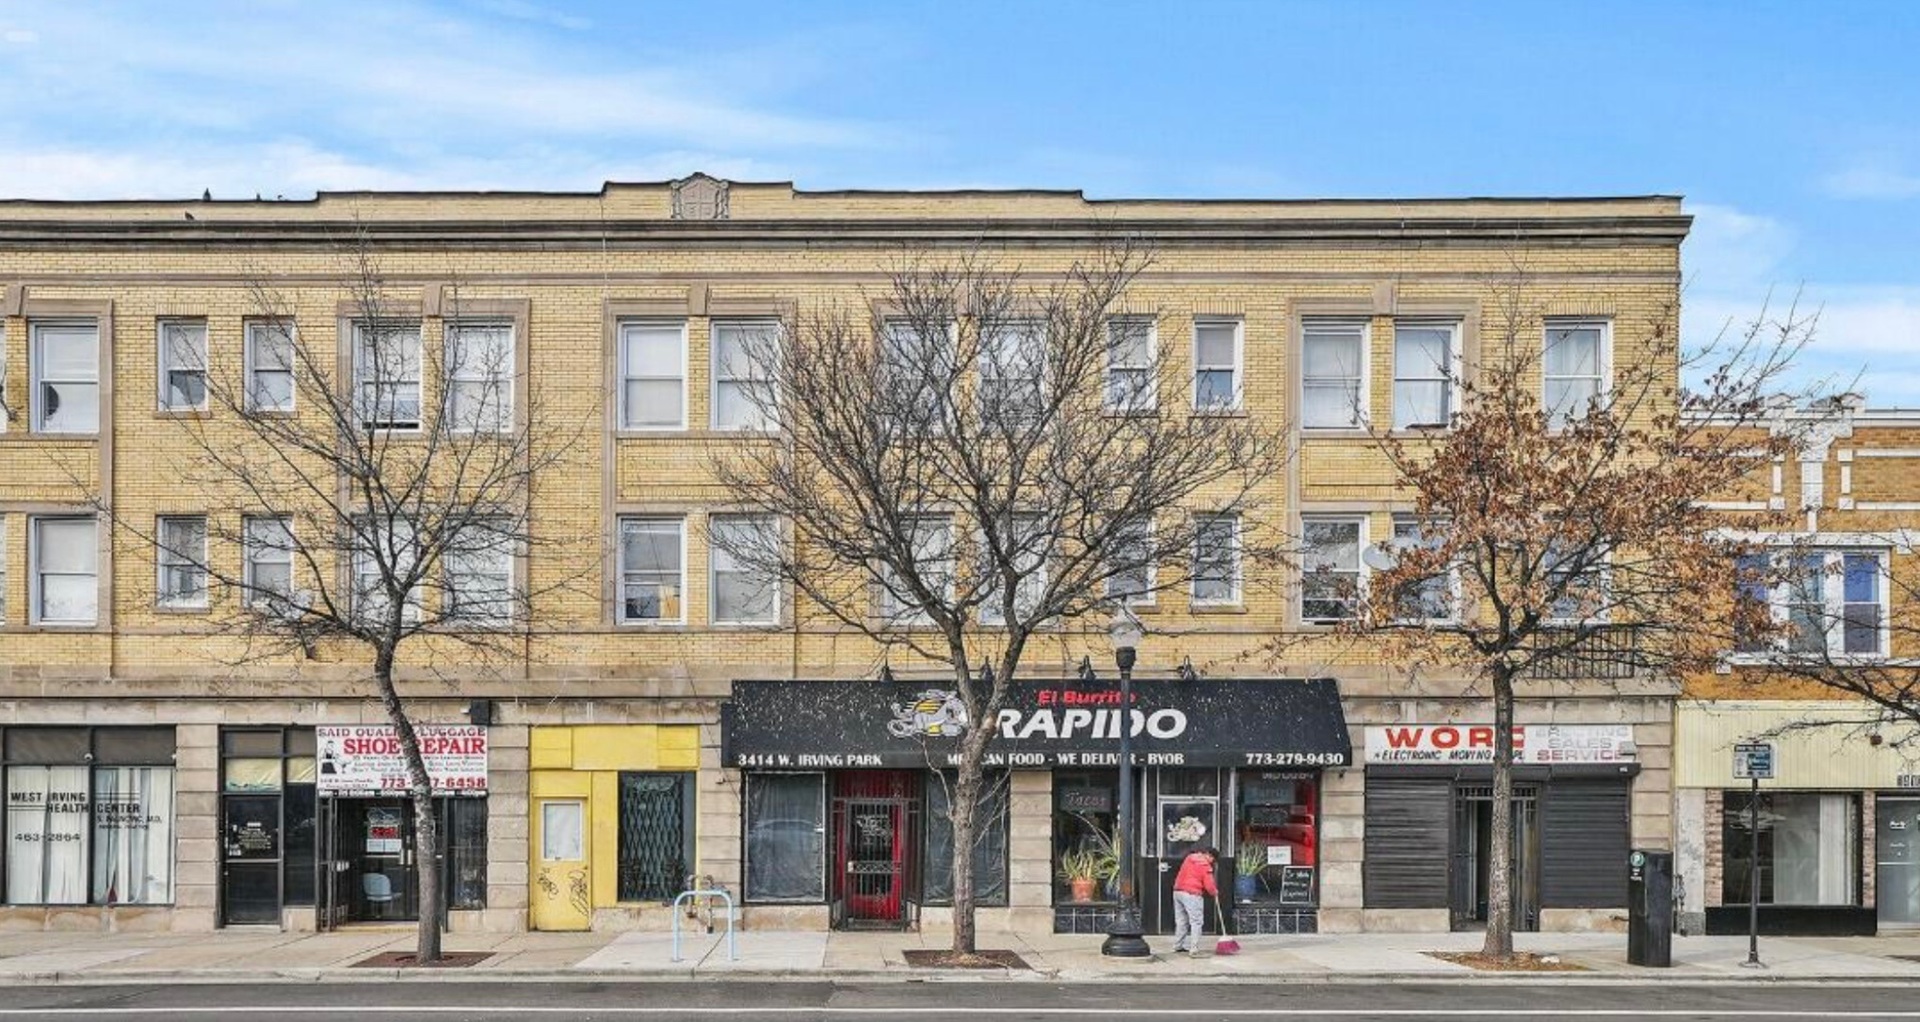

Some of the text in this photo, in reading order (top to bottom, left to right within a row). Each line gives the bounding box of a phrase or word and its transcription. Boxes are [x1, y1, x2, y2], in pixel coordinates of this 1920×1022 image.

[1038, 690, 1058, 704] El
[993, 708, 1188, 739] RAPIDO
[318, 728, 350, 737] SAID
[420, 727, 486, 737] LUGGAGE
[343, 738, 401, 755] SHOE
[1548, 737, 1612, 749] SALES
[737, 754, 882, 766] 3414 W. IRVING PARK
[1008, 753, 1045, 765] FOOD
[1056, 753, 1077, 765] WE
[1081, 753, 1136, 765] DELIVR
[1147, 753, 1184, 765] BYOB
[1245, 753, 1344, 765] 773-279-9430
[1381, 749, 1442, 761] ELECTRONIC
[380, 777, 486, 788] 773-7-6458
[10, 792, 42, 802] WEST
[46, 803, 141, 813] HEALTH CENTER
[14, 833, 81, 842] 463-2864
